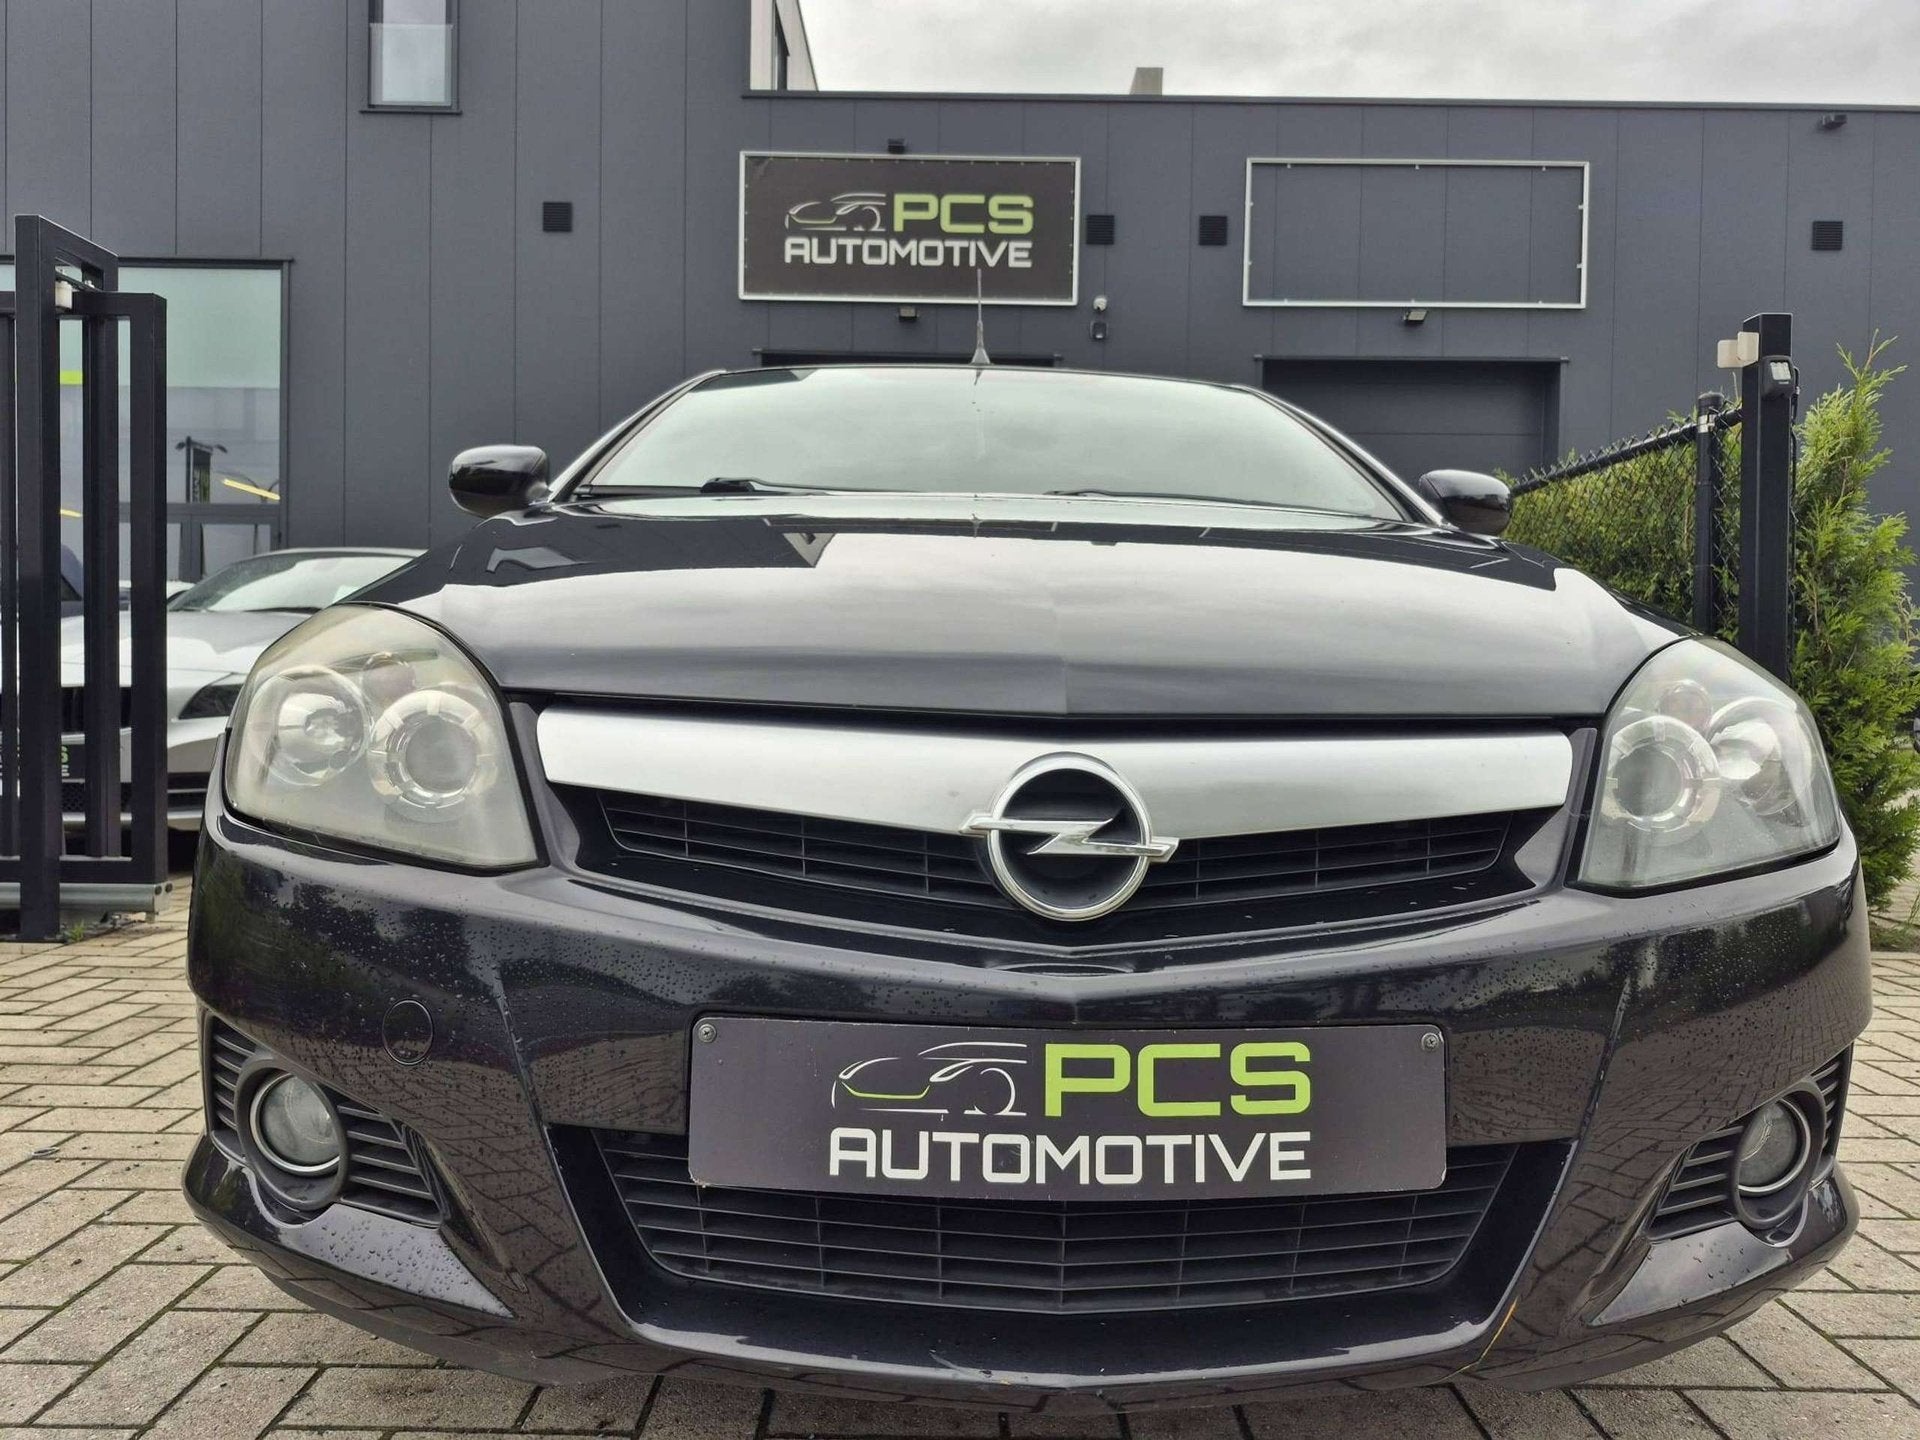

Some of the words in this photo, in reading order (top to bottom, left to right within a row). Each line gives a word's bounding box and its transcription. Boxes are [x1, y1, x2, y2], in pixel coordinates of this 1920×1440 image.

[894, 193, 1034, 234] PCS
[784, 236, 1033, 268] AUTOMOTIVE
[1044, 1042, 1311, 1117] PCS
[829, 1127, 1311, 1185] AUTOMOTIVE
